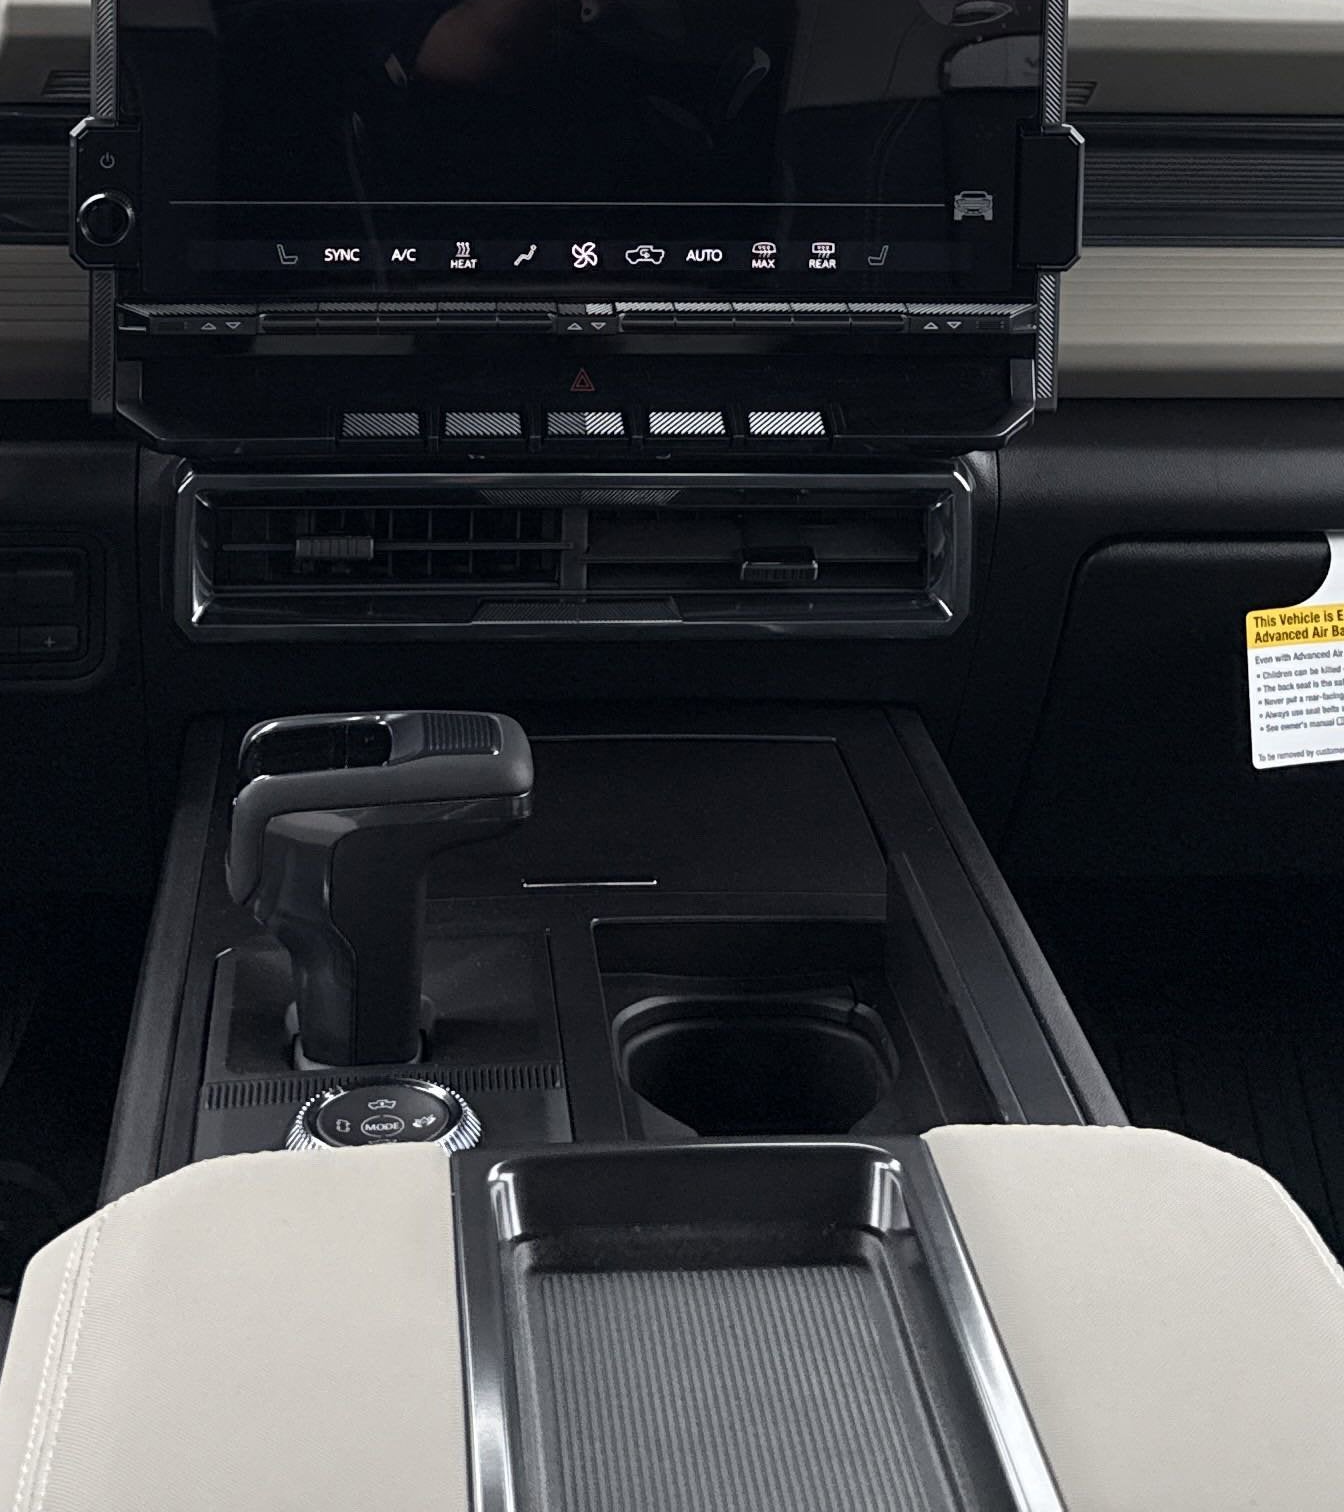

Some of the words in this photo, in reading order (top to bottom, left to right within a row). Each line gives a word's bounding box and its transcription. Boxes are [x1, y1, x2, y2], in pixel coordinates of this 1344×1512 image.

[324, 248, 360, 262] SYNC
[391, 248, 417, 262] A/C
[685, 249, 723, 262] AUTO
[450, 259, 478, 269] HEAT
[751, 259, 776, 269] MAX
[808, 259, 837, 270] REAR
[1254, 615, 1277, 629] This
[1280, 612, 1320, 627] Vehicle
[1323, 611, 1334, 623] is
[1254, 629, 1309, 644] Advanced
[1312, 626, 1328, 638] Air
[1255, 656, 1273, 665] Even
[1275, 654, 1291, 662] with
[1293, 650, 1331, 661] Advanced
[1333, 649, 1343, 657] Air
[1262, 670, 1293, 679] Children
[1294, 669, 1307, 677] can
[1264, 684, 1276, 693] The
[1278, 683, 1294, 691] back
[1296, 681, 1311, 690] seat
[1321, 679, 1332, 687] the
[1264, 698, 1284, 706] Never
[1265, 710, 1289, 719] Always
[1266, 724, 1279, 732] See
[1258, 754, 1266, 762] To
[1267, 753, 1276, 761] be
[1277, 750, 1305, 759] removed
[1306, 750, 1314, 758] by
[364, 1122, 399, 1131] MODE
